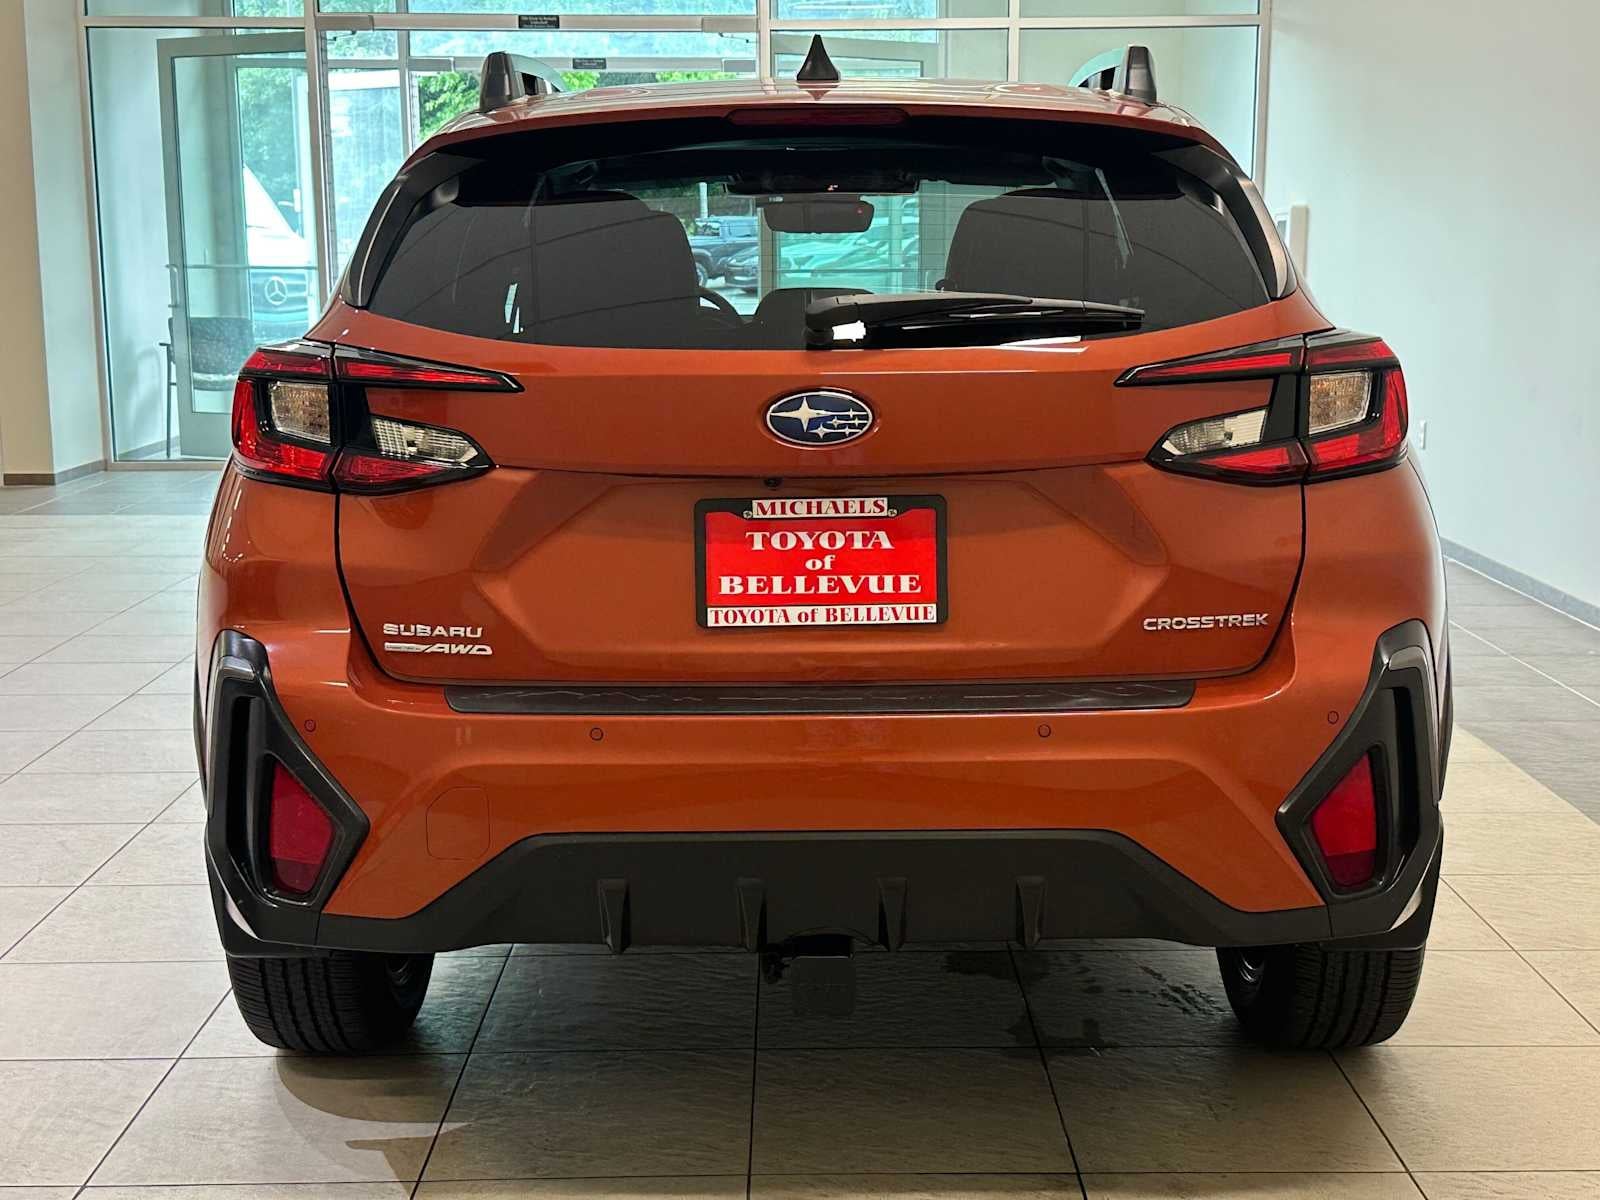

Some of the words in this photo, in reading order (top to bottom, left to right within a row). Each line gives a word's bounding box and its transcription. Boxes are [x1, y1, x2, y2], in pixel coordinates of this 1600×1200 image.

[755, 500, 886, 516] MICHAELS
[745, 530, 894, 551] TOYOTA
[805, 554, 836, 571] of
[719, 574, 922, 595] BELLEVUE
[710, 608, 790, 624] TOYOTA
[797, 607, 819, 623] of
[825, 605, 935, 622] BELLEVUE
[1143, 613, 1269, 631] CROSSTREK
[383, 623, 483, 638] SUBARU
[424, 643, 493, 655] AWD
